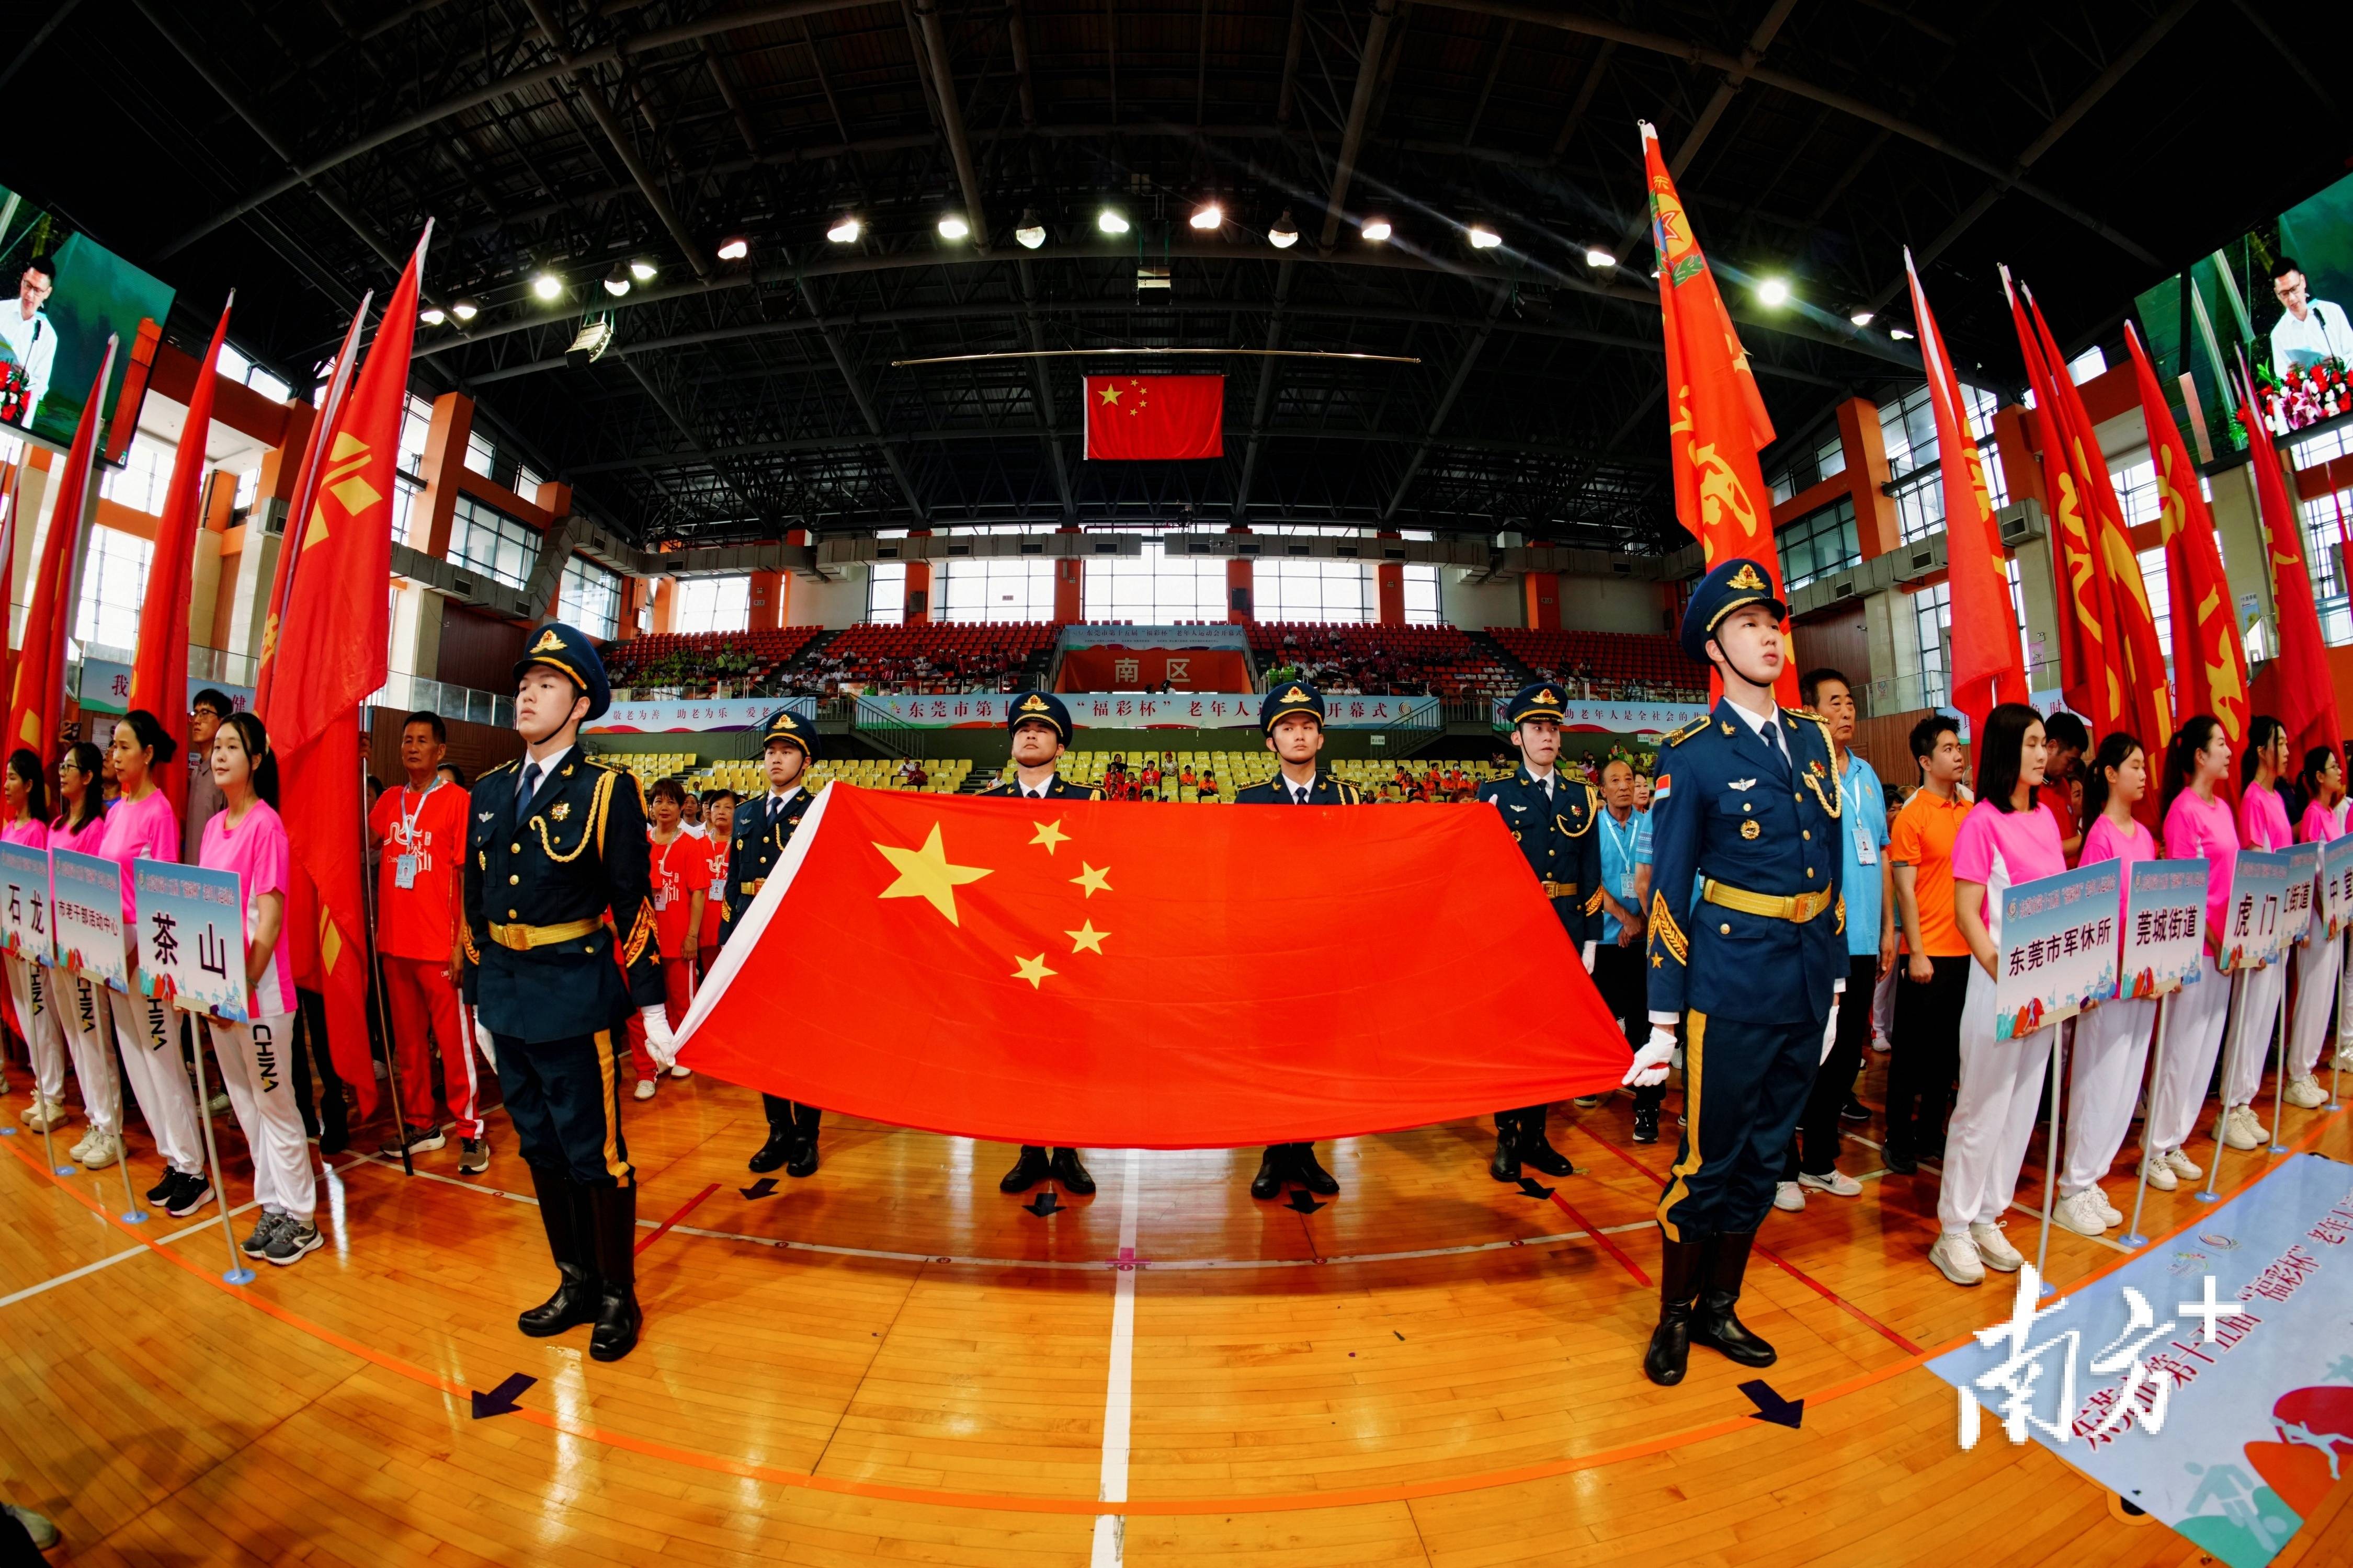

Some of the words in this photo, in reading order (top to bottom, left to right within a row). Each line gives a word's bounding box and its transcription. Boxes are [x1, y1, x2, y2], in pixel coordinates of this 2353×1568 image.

[111, 674, 129, 697] 我
[1115, 658, 1191, 683] 南区
[613, 709, 660, 720] 敬老为善
[677, 707, 728, 719] 助老为乐
[908, 701, 1008, 718] 东莞市第十
[1077, 700, 1171, 717] “福彩杯”
[1565, 708, 1708, 721] 助老年人是全社会的
[9, 883, 44, 935] 石龙
[58, 899, 118, 936] 市老干部活动中心
[2136, 906, 2197, 946] 莞城街道
[2234, 892, 2277, 937] 虎门
[152, 912, 226, 980] 茶山
[2008, 917, 2111, 977] 东莞市军休所
[31, 967, 44, 1016] HINA
[147, 994, 167, 1051] HINA
[253, 1024, 279, 1093] CHINA
[2236, 1244, 2320, 1302] “福彩杯”
[2306, 1195, 2353, 1245] 老年人
